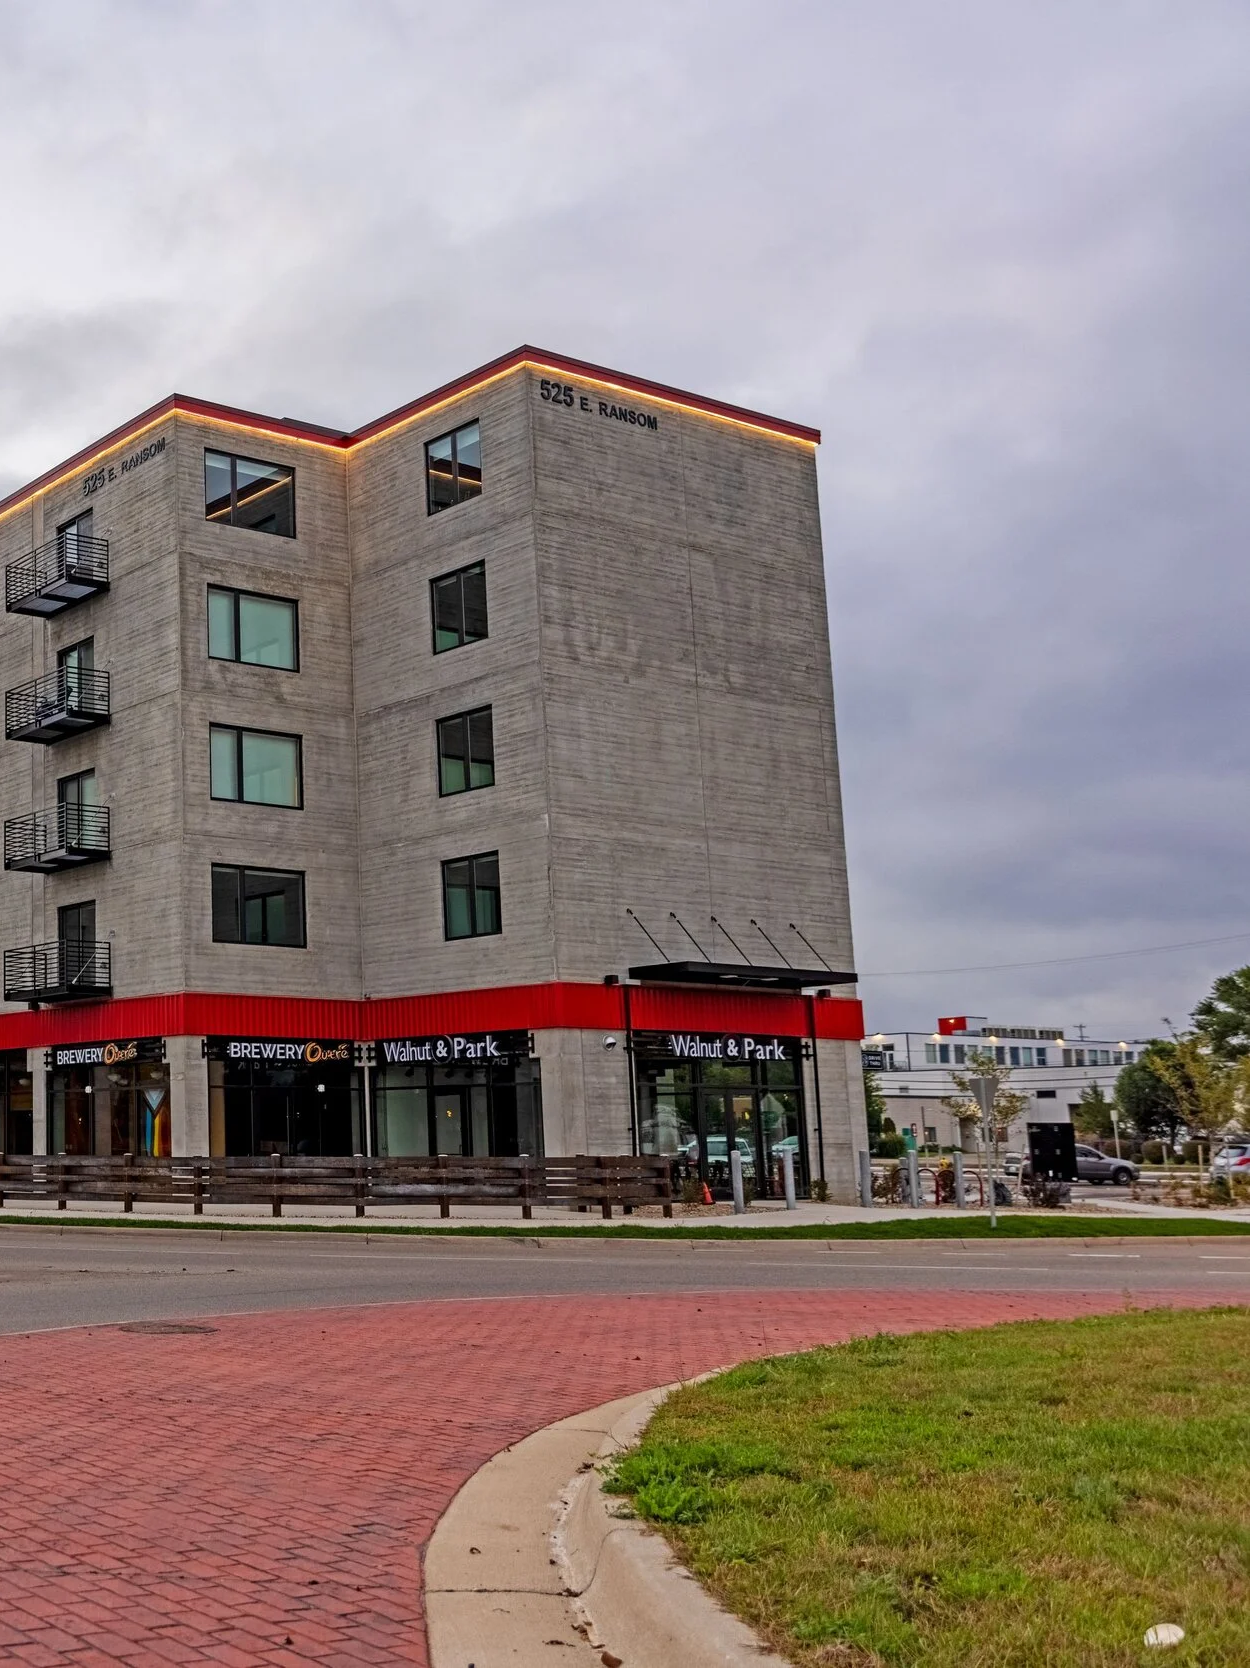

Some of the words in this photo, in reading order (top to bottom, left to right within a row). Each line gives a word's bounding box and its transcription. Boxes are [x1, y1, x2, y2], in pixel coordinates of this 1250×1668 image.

[540, 379, 575, 407] 525
[580, 396, 592, 413] E.
[598, 401, 658, 430] RANSOM
[82, 467, 106, 496] 525
[107, 468, 117, 482] E.
[121, 437, 166, 475] RANSOM
[56, 1047, 104, 1065] BREWERY
[230, 1042, 305, 1060] BREWERY
[383, 1040, 432, 1063] Walnut
[436, 1040, 448, 1057] &
[453, 1035, 501, 1059] Park
[670, 1034, 723, 1058] Walnut
[727, 1038, 739, 1056] &
[743, 1038, 786, 1060] Park
